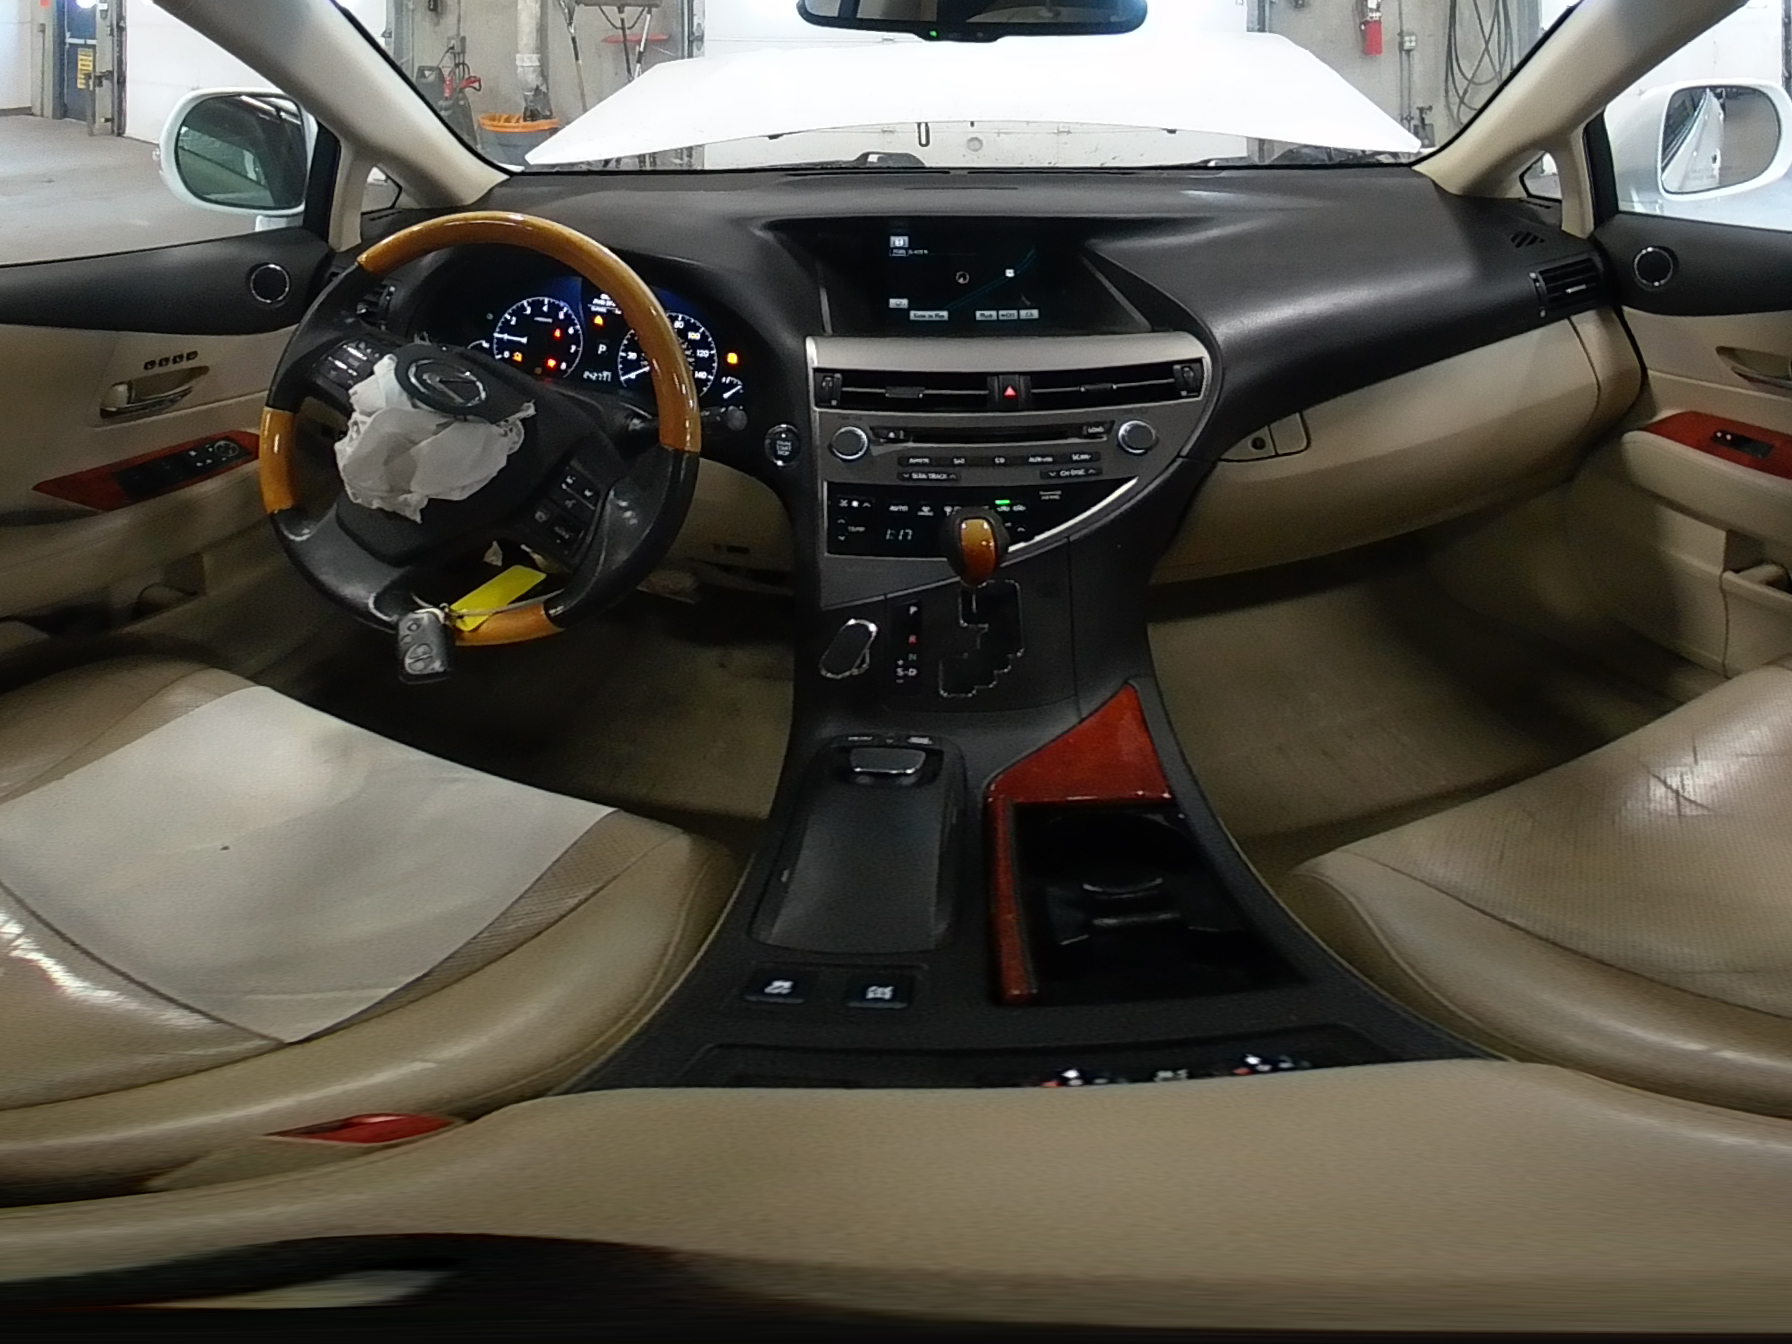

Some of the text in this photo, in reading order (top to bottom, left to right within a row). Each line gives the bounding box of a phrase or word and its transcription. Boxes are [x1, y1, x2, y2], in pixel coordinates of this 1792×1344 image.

[674, 320, 685, 329] 80
[687, 331, 701, 340] 100
[598, 344, 607, 354] P
[696, 349, 710, 358] 120
[503, 350, 510, 358] 0
[627, 351, 638, 360] 20
[694, 371, 707, 379] 140
[909, 605, 918, 615] P
[908, 634, 917, 644] R
[908, 653, 918, 661] N
